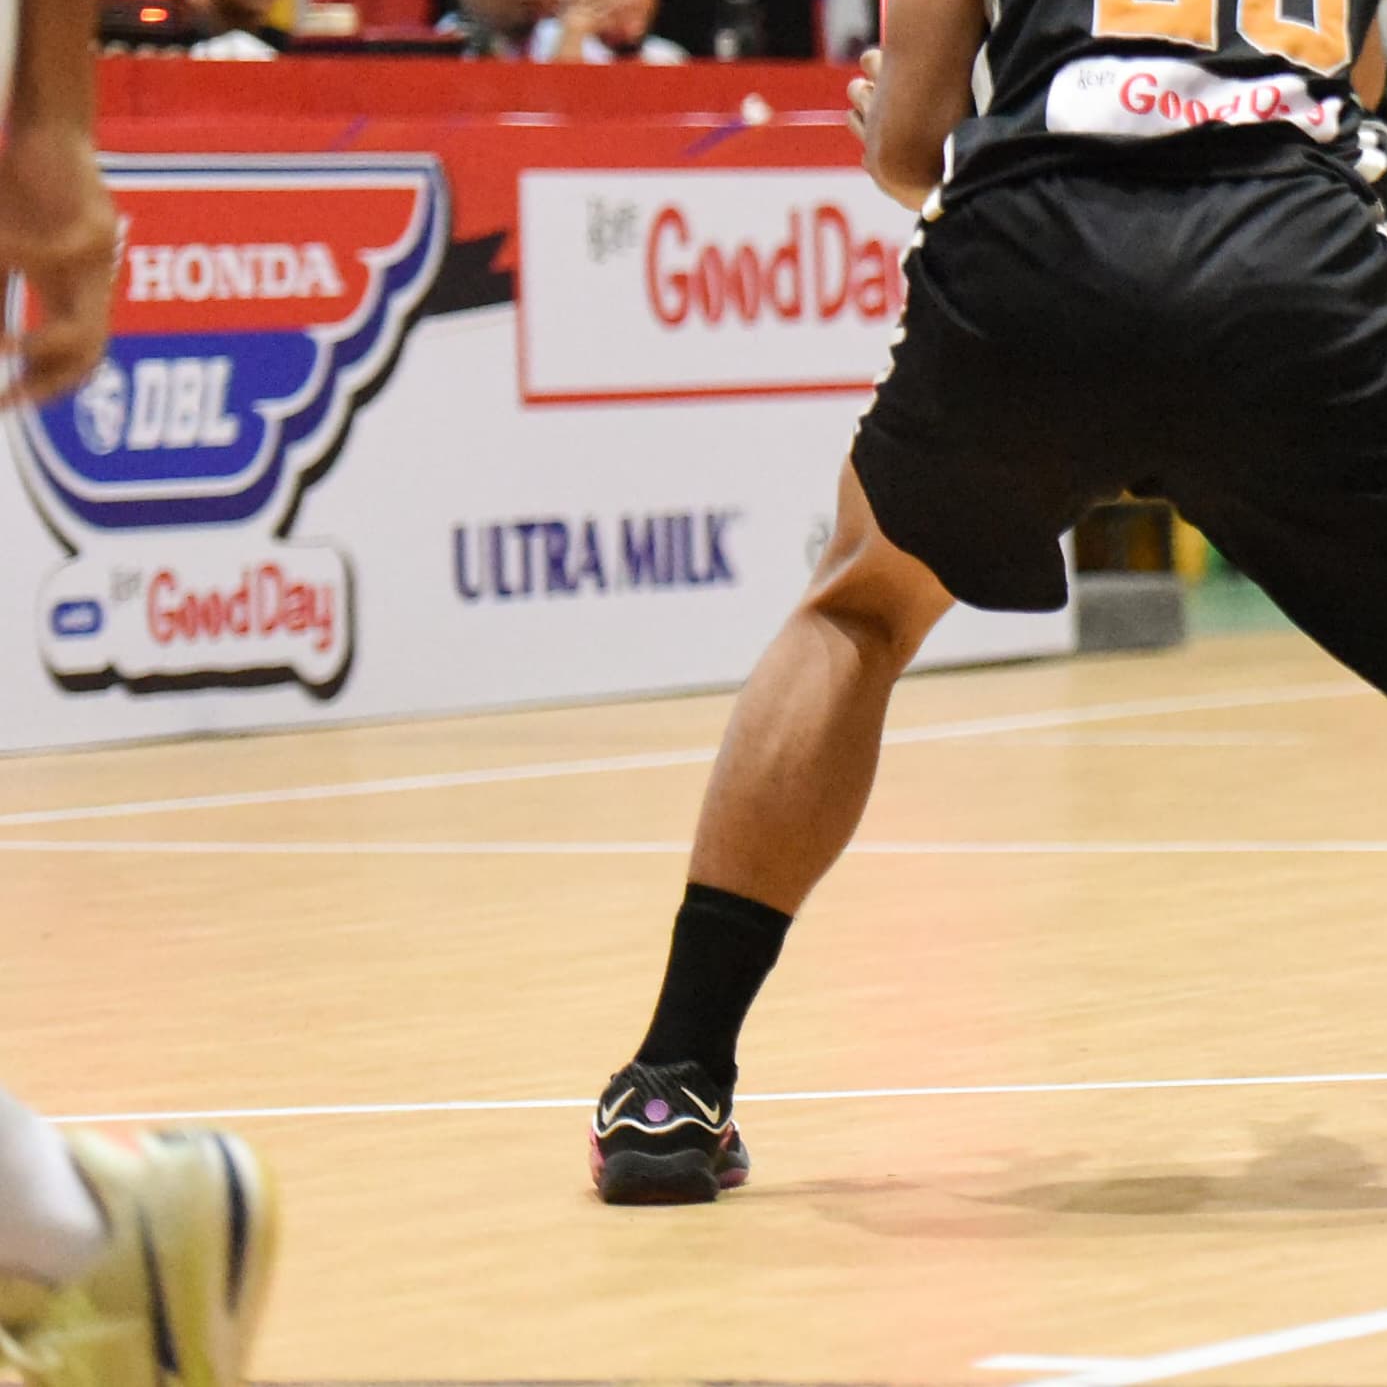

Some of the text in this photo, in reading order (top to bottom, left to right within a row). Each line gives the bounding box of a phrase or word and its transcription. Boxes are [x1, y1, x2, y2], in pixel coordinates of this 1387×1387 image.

[127, 242, 345, 301] HONDA
[127, 356, 240, 450] DBL
[452, 519, 606, 599] ULTRA
[620, 512, 737, 587] MILK
